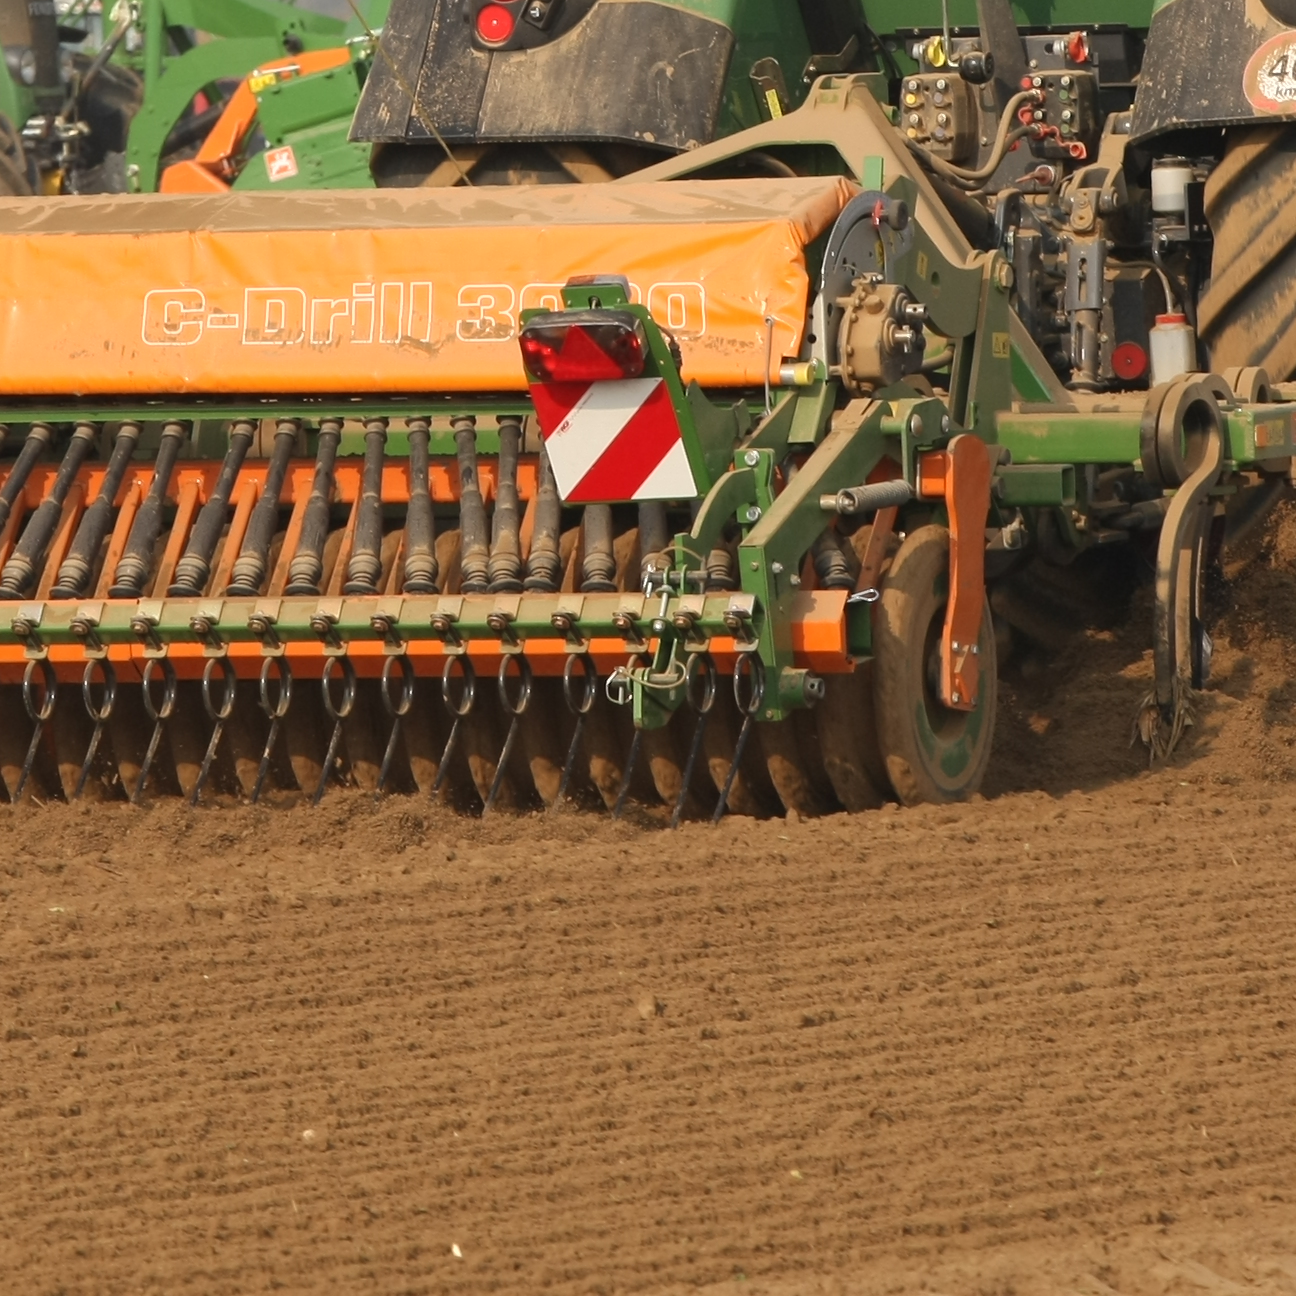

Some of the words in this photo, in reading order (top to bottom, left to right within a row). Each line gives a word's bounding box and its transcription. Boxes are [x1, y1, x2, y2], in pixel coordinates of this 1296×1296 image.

[1275, 86, 1296, 97] km
[141, 281, 433, 346] C-Drill
[456, 282, 706, 342] 30
